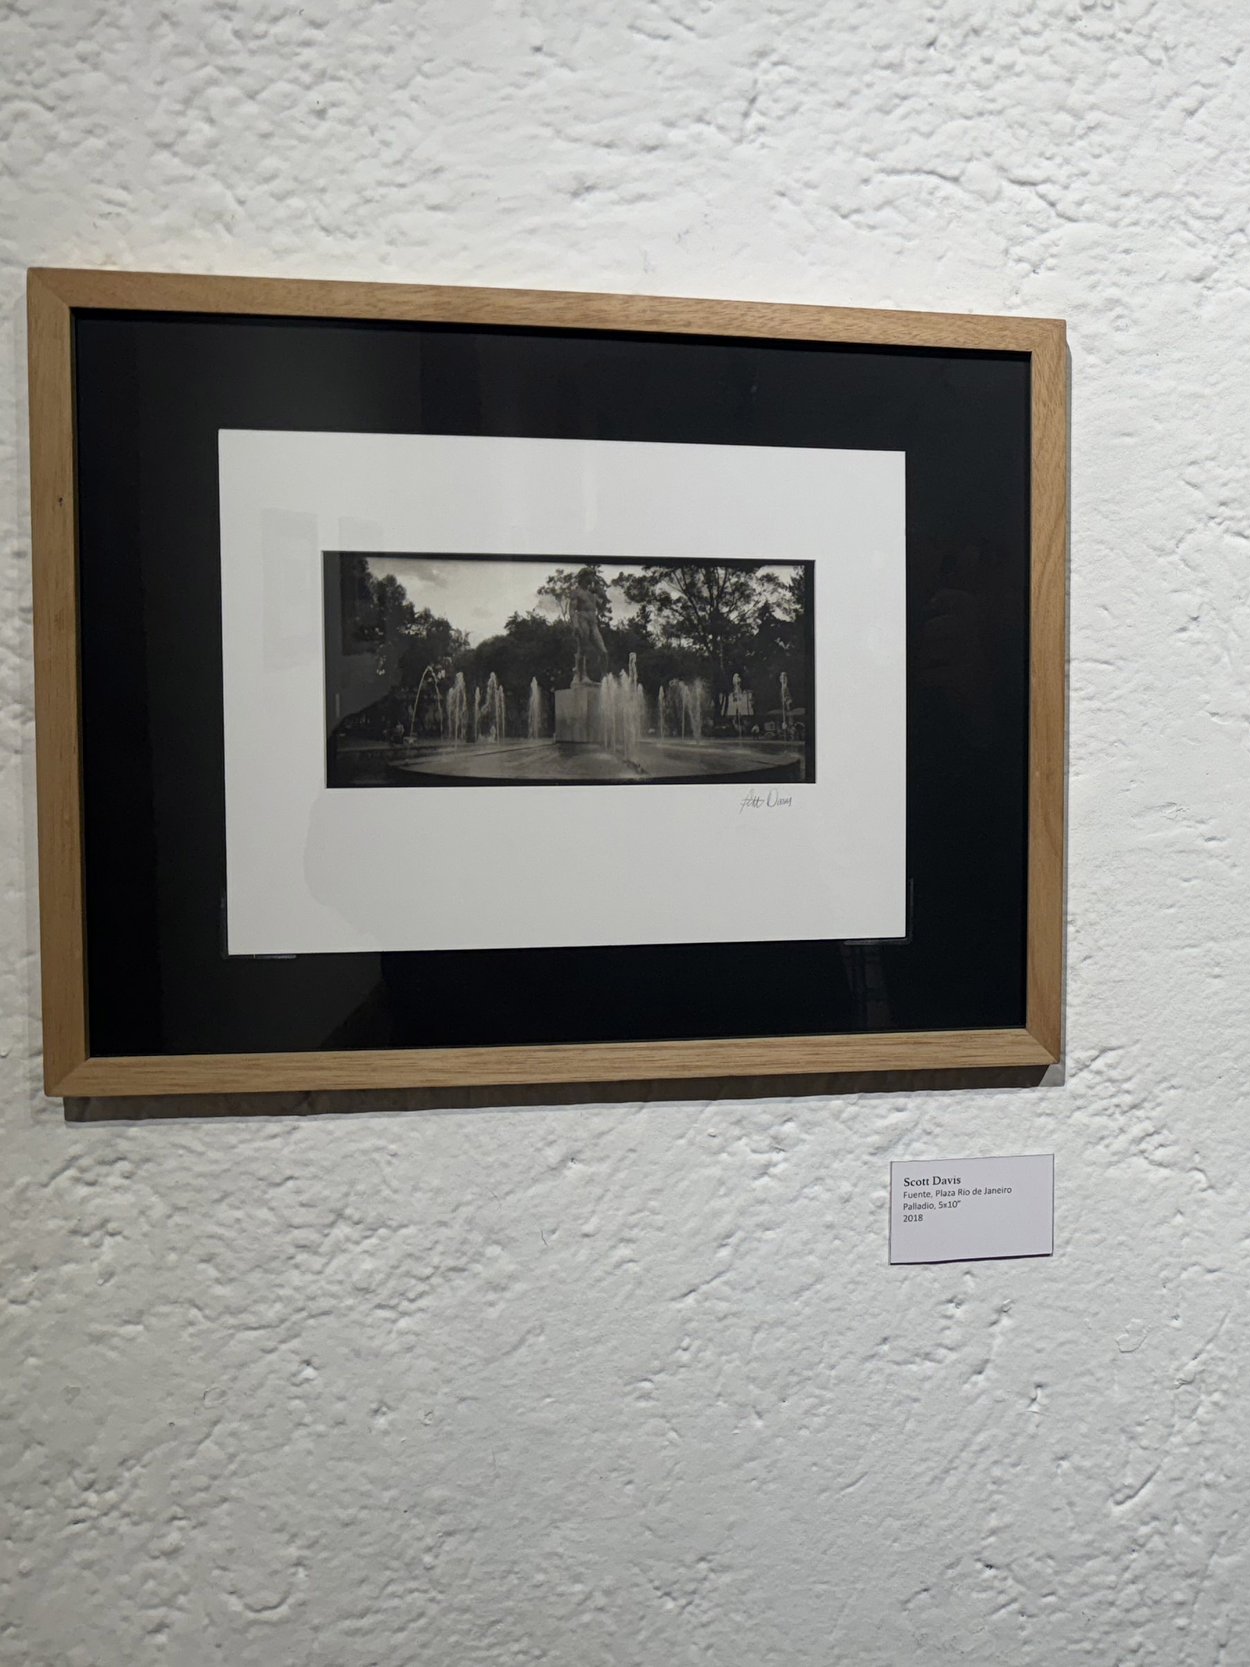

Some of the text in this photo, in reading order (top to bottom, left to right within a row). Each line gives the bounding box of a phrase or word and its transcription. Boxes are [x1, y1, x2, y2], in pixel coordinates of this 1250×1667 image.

[903, 1175, 962, 1187] Scott Davis
[903, 1186, 1013, 1199] Fuente, Plaza Rio de Janeiro
[903, 1202, 936, 1211] Palladio,
[903, 1213, 924, 1223] 2018
